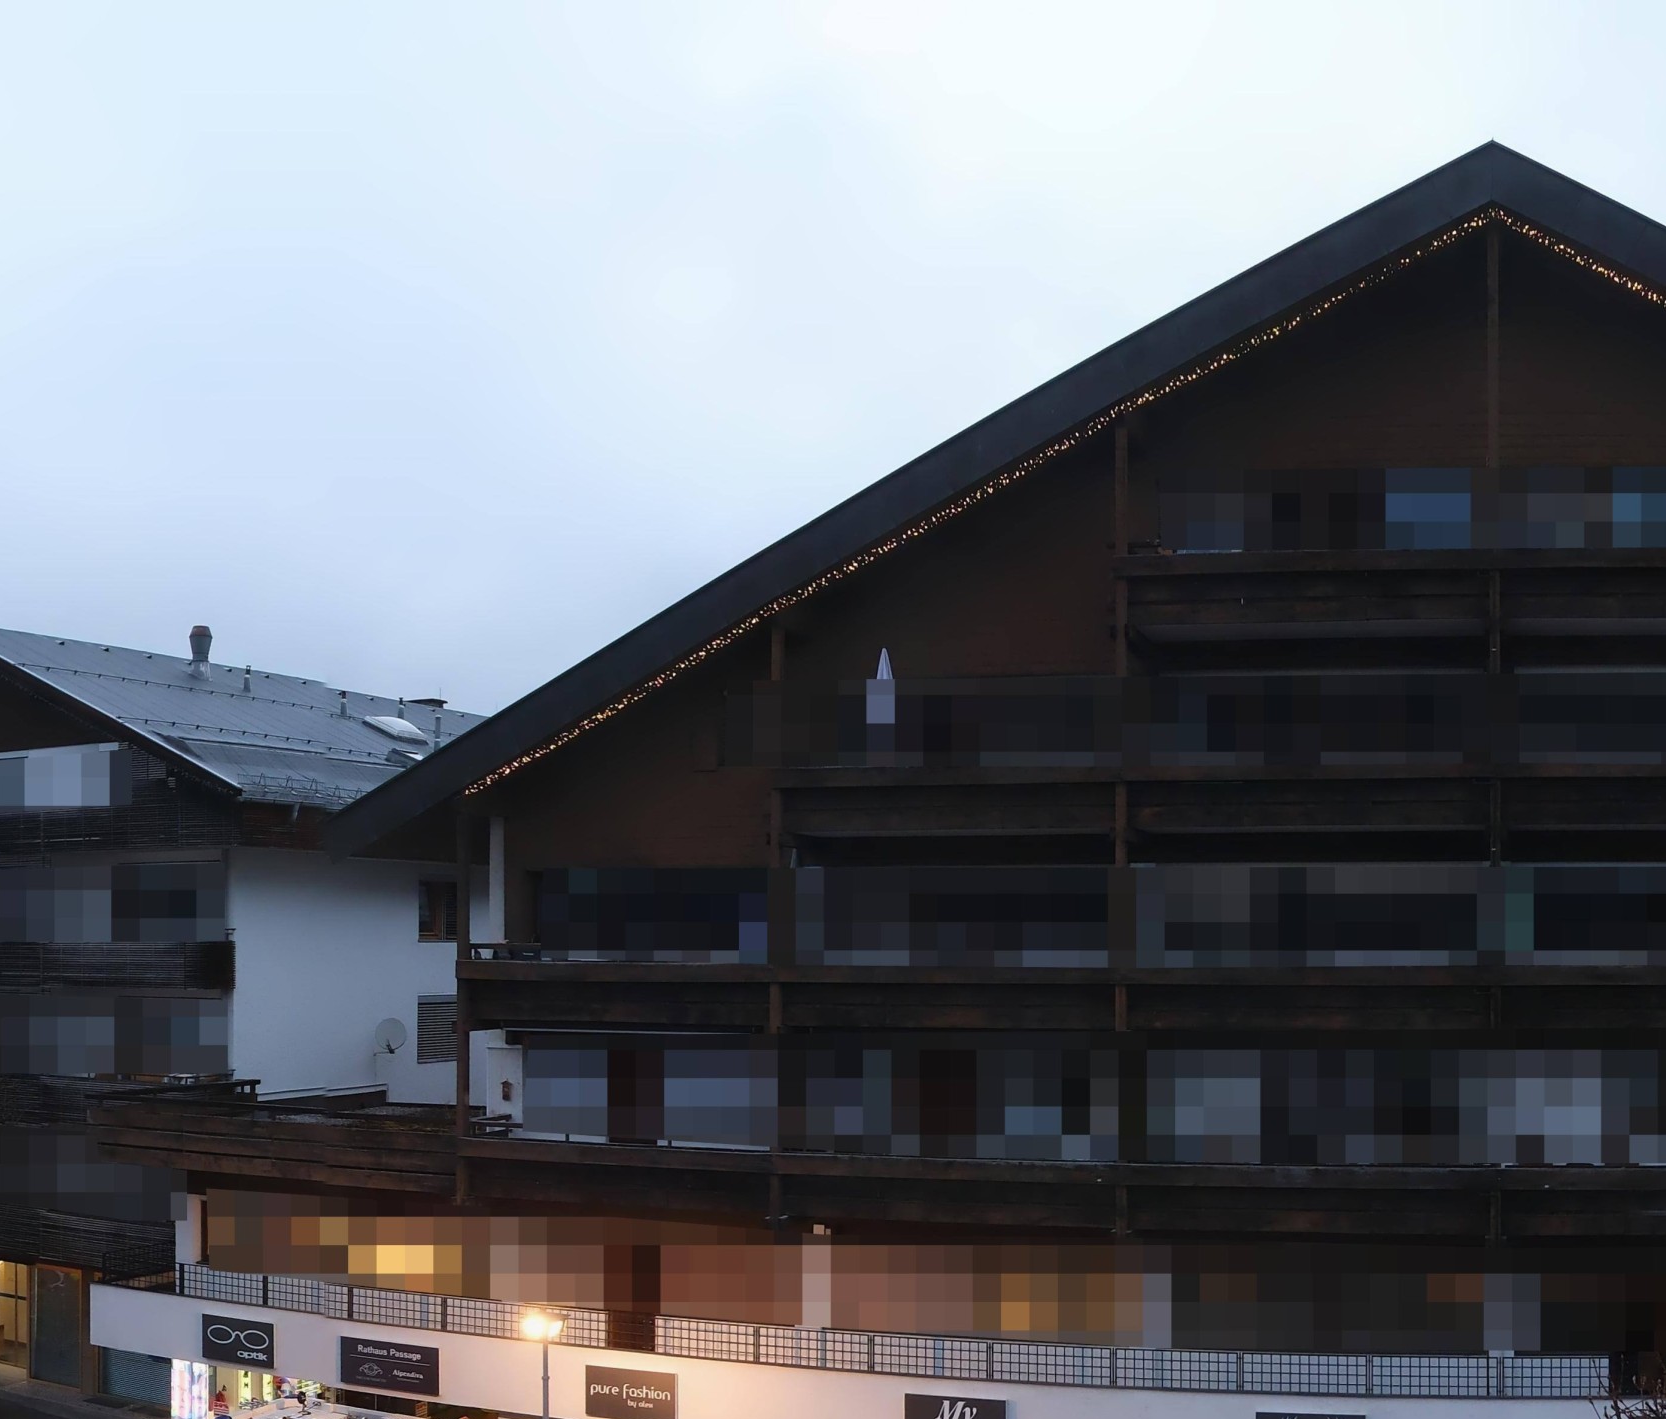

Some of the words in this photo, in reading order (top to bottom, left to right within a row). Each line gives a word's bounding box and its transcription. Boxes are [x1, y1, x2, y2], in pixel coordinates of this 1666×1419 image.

[236, 1349, 268, 1362] optik
[356, 1343, 388, 1356] Rathaus
[389, 1347, 423, 1362] Passage
[589, 1383, 620, 1396] pure
[622, 1383, 671, 1401] fashion
